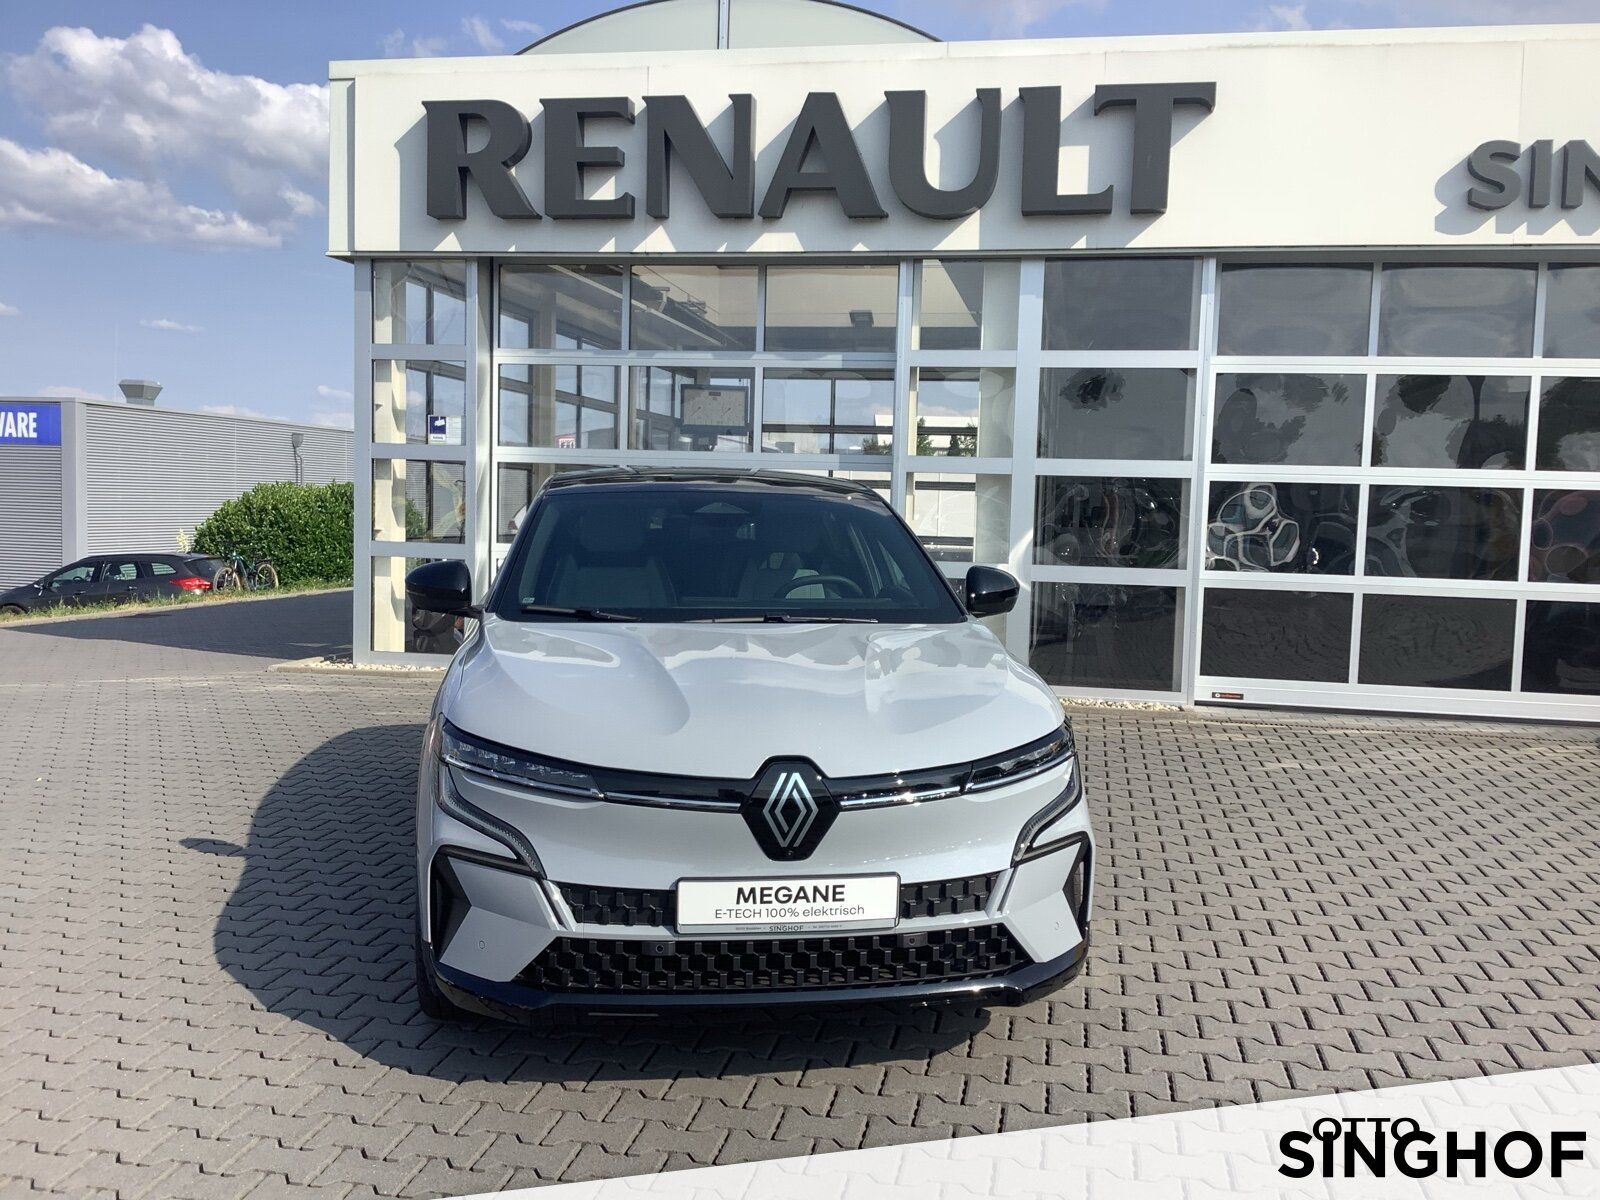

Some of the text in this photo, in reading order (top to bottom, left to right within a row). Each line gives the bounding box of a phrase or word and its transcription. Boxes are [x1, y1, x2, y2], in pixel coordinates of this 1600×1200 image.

[421, 81, 1217, 220] RENAULT
[1467, 139, 1600, 211] SIN
[735, 884, 846, 905] MEGANE
[715, 904, 865, 919] E-TECH 100% elektrisch
[769, 924, 804, 932] SINGHOF
